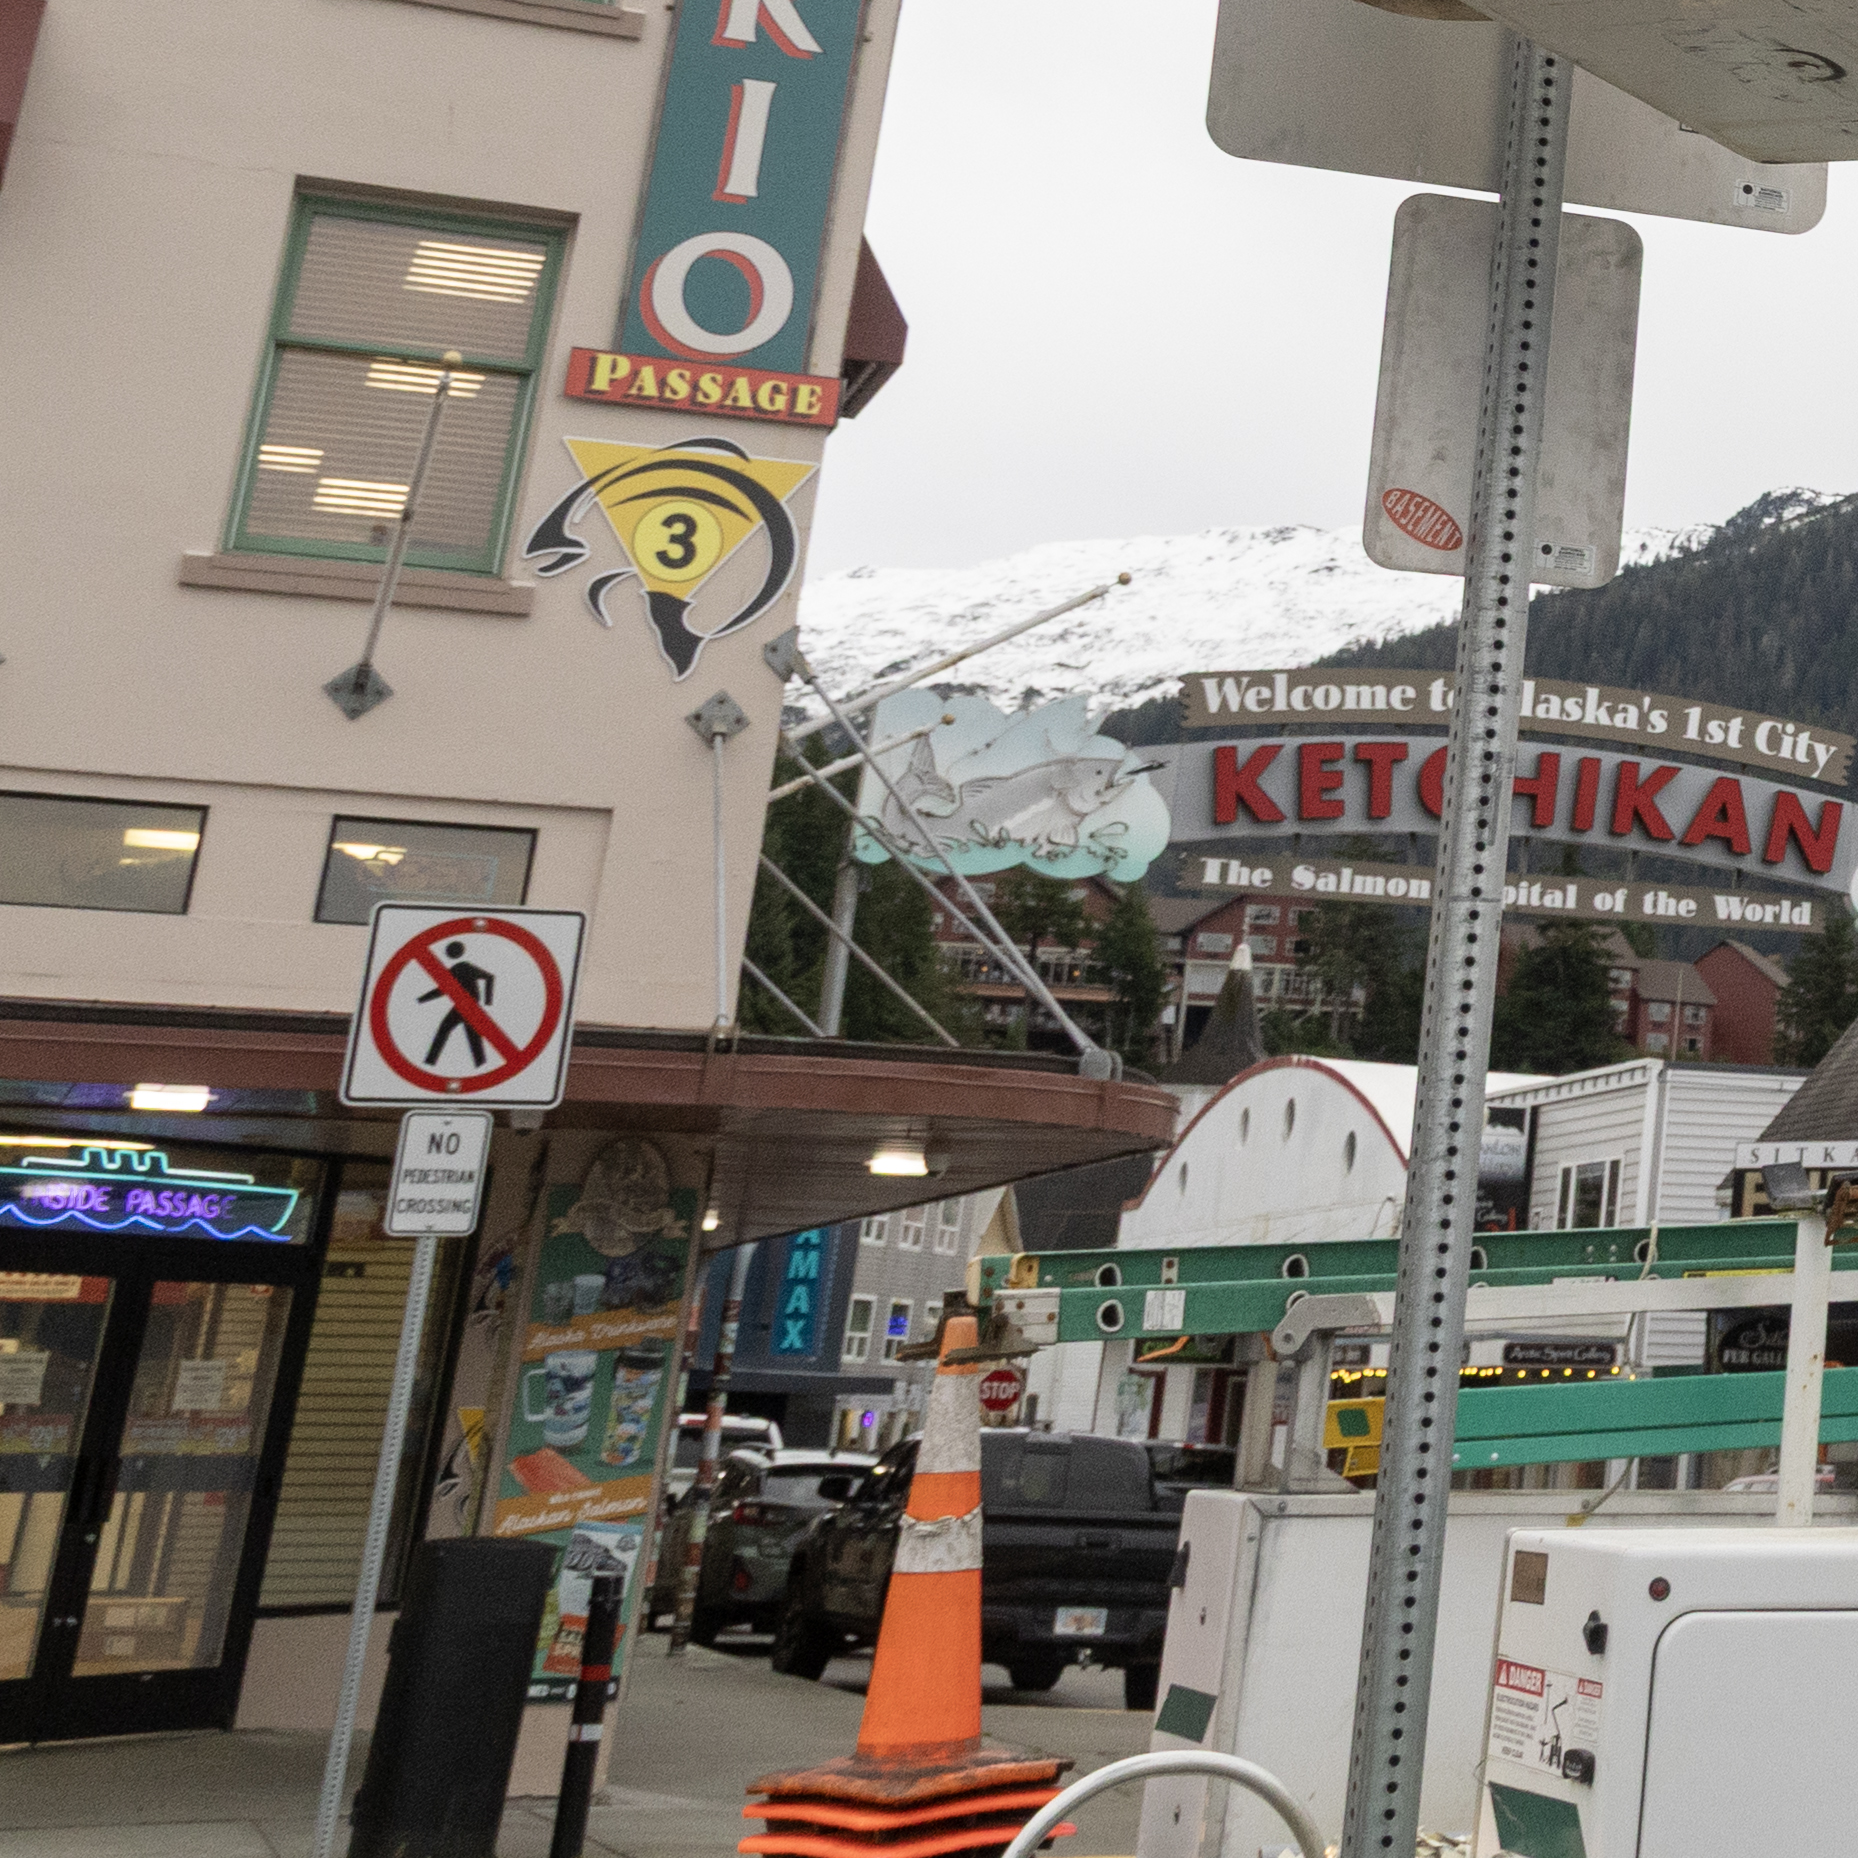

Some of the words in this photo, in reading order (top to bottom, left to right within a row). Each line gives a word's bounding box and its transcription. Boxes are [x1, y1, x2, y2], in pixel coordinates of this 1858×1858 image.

[588, 352, 823, 416] PASSAGE
[1385, 490, 1461, 549] BASEMENT
[655, 512, 698, 570] 3
[1200, 673, 1417, 714] Welcome
[1519, 679, 1669, 734] laska's
[1681, 706, 1745, 749] 1st
[1754, 720, 1838, 779] City
[1200, 856, 1274, 888] The
[1291, 864, 1431, 899] Salmon
[1501, 880, 1578, 911] pital
[1592, 888, 1628, 914] of
[1641, 890, 1698, 918] the
[1713, 894, 1812, 926] World
[427, 1132, 461, 1155] NO
[403, 1168, 476, 1184] PEDESTRIAN
[124, 1188, 237, 1220] PASSAGE
[396, 1198, 471, 1214] CROSSING
[980, 1380, 1021, 1400] STOP
[1508, 1665, 1543, 1695] DANGER
